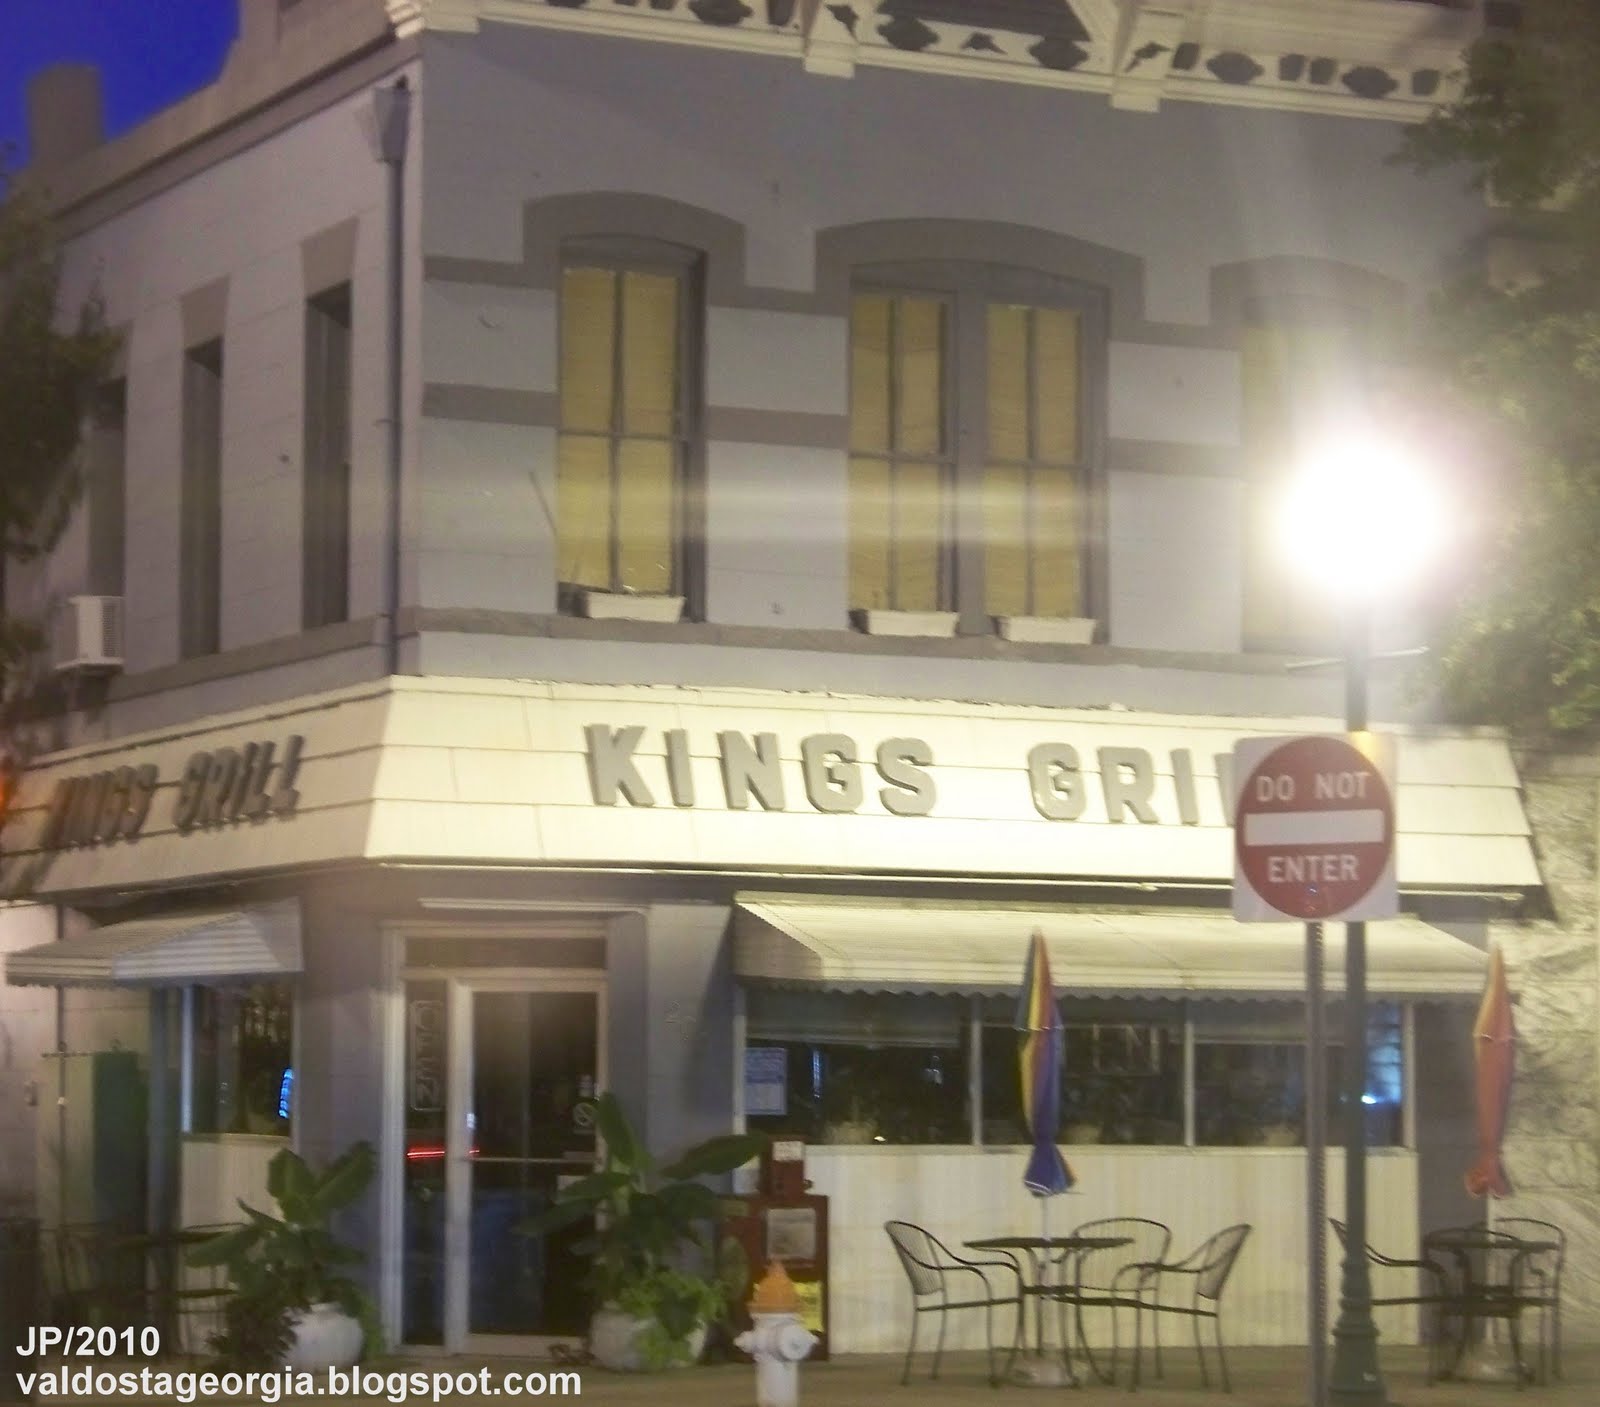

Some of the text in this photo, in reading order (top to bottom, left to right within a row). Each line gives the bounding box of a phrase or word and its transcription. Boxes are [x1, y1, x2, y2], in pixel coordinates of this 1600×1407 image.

[173, 734, 305, 837] GRILL
[584, 723, 1235, 828] KINGS GRI
[1255, 771, 1370, 802] DO NOT
[1267, 855, 1360, 883] ENTER
